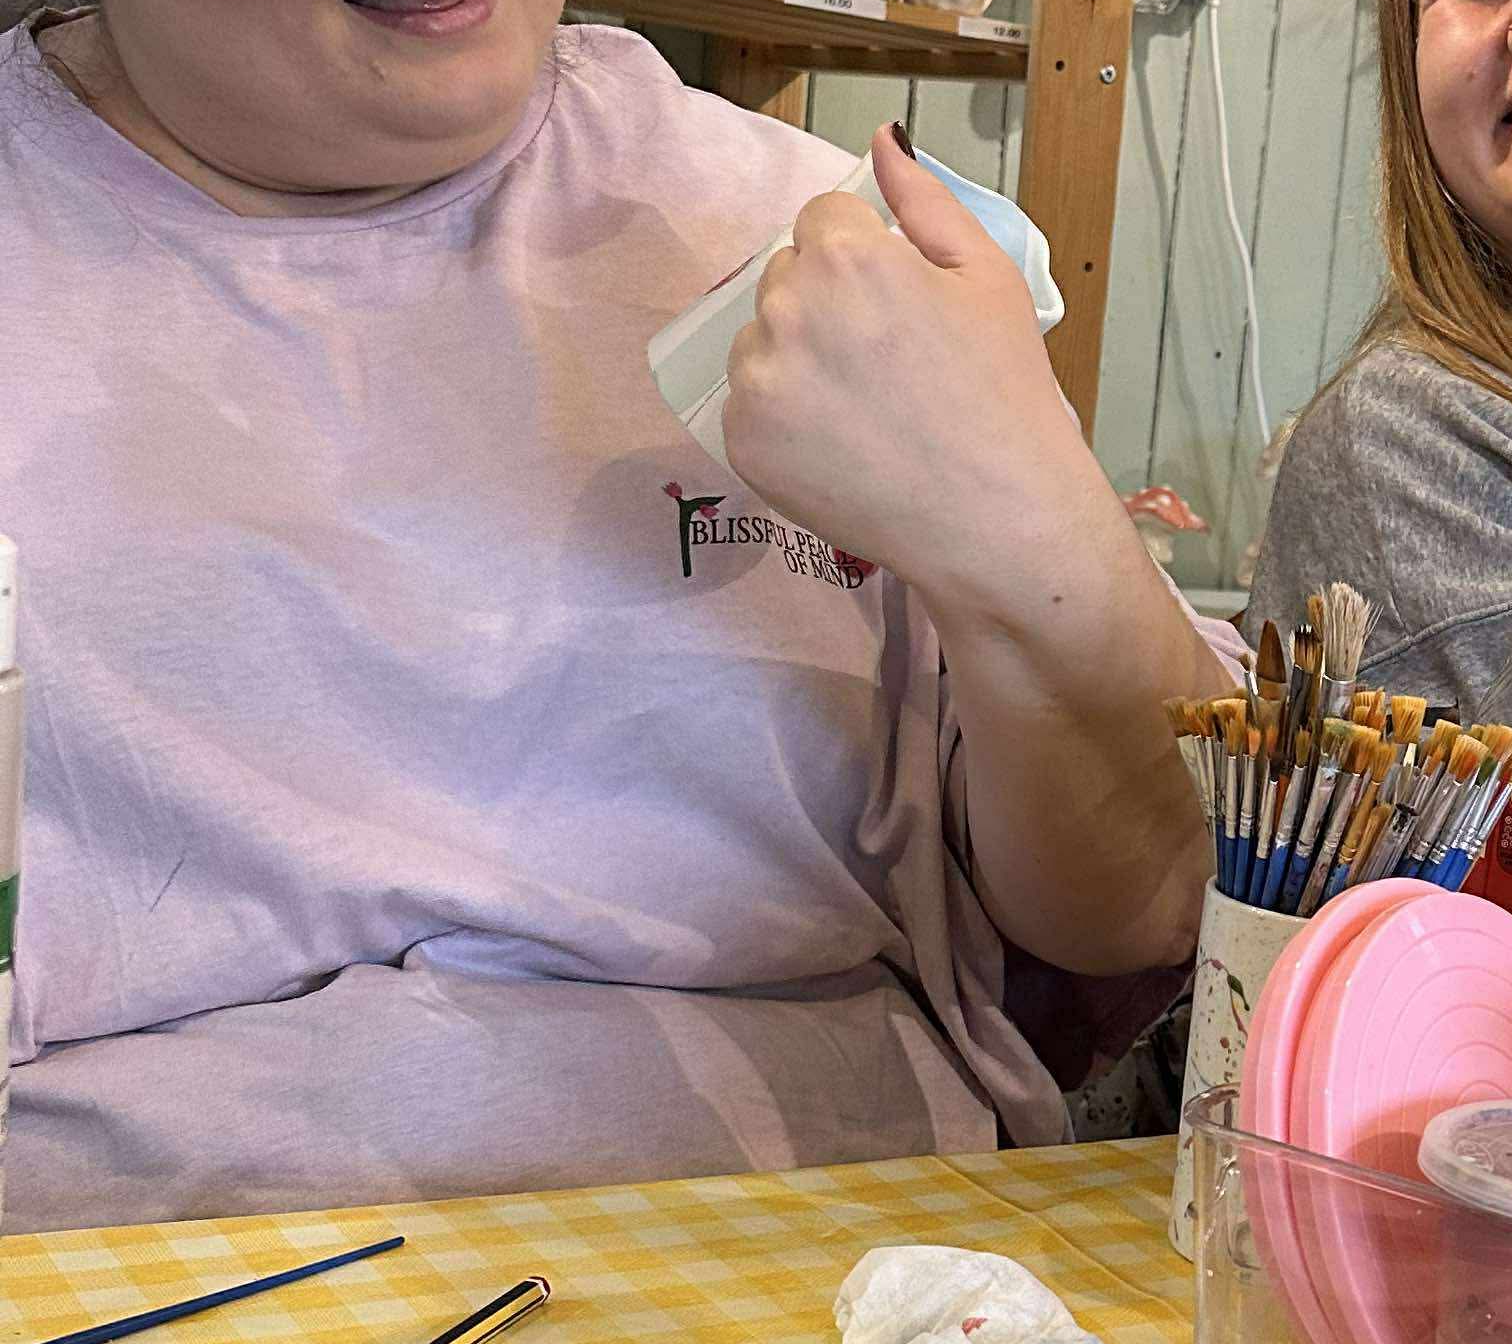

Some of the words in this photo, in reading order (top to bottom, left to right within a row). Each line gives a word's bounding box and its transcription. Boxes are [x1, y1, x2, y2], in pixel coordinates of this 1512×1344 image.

[690, 516, 796, 551] BLISSFUL
[784, 549, 807, 575] OF
[808, 555, 864, 589] MIND
